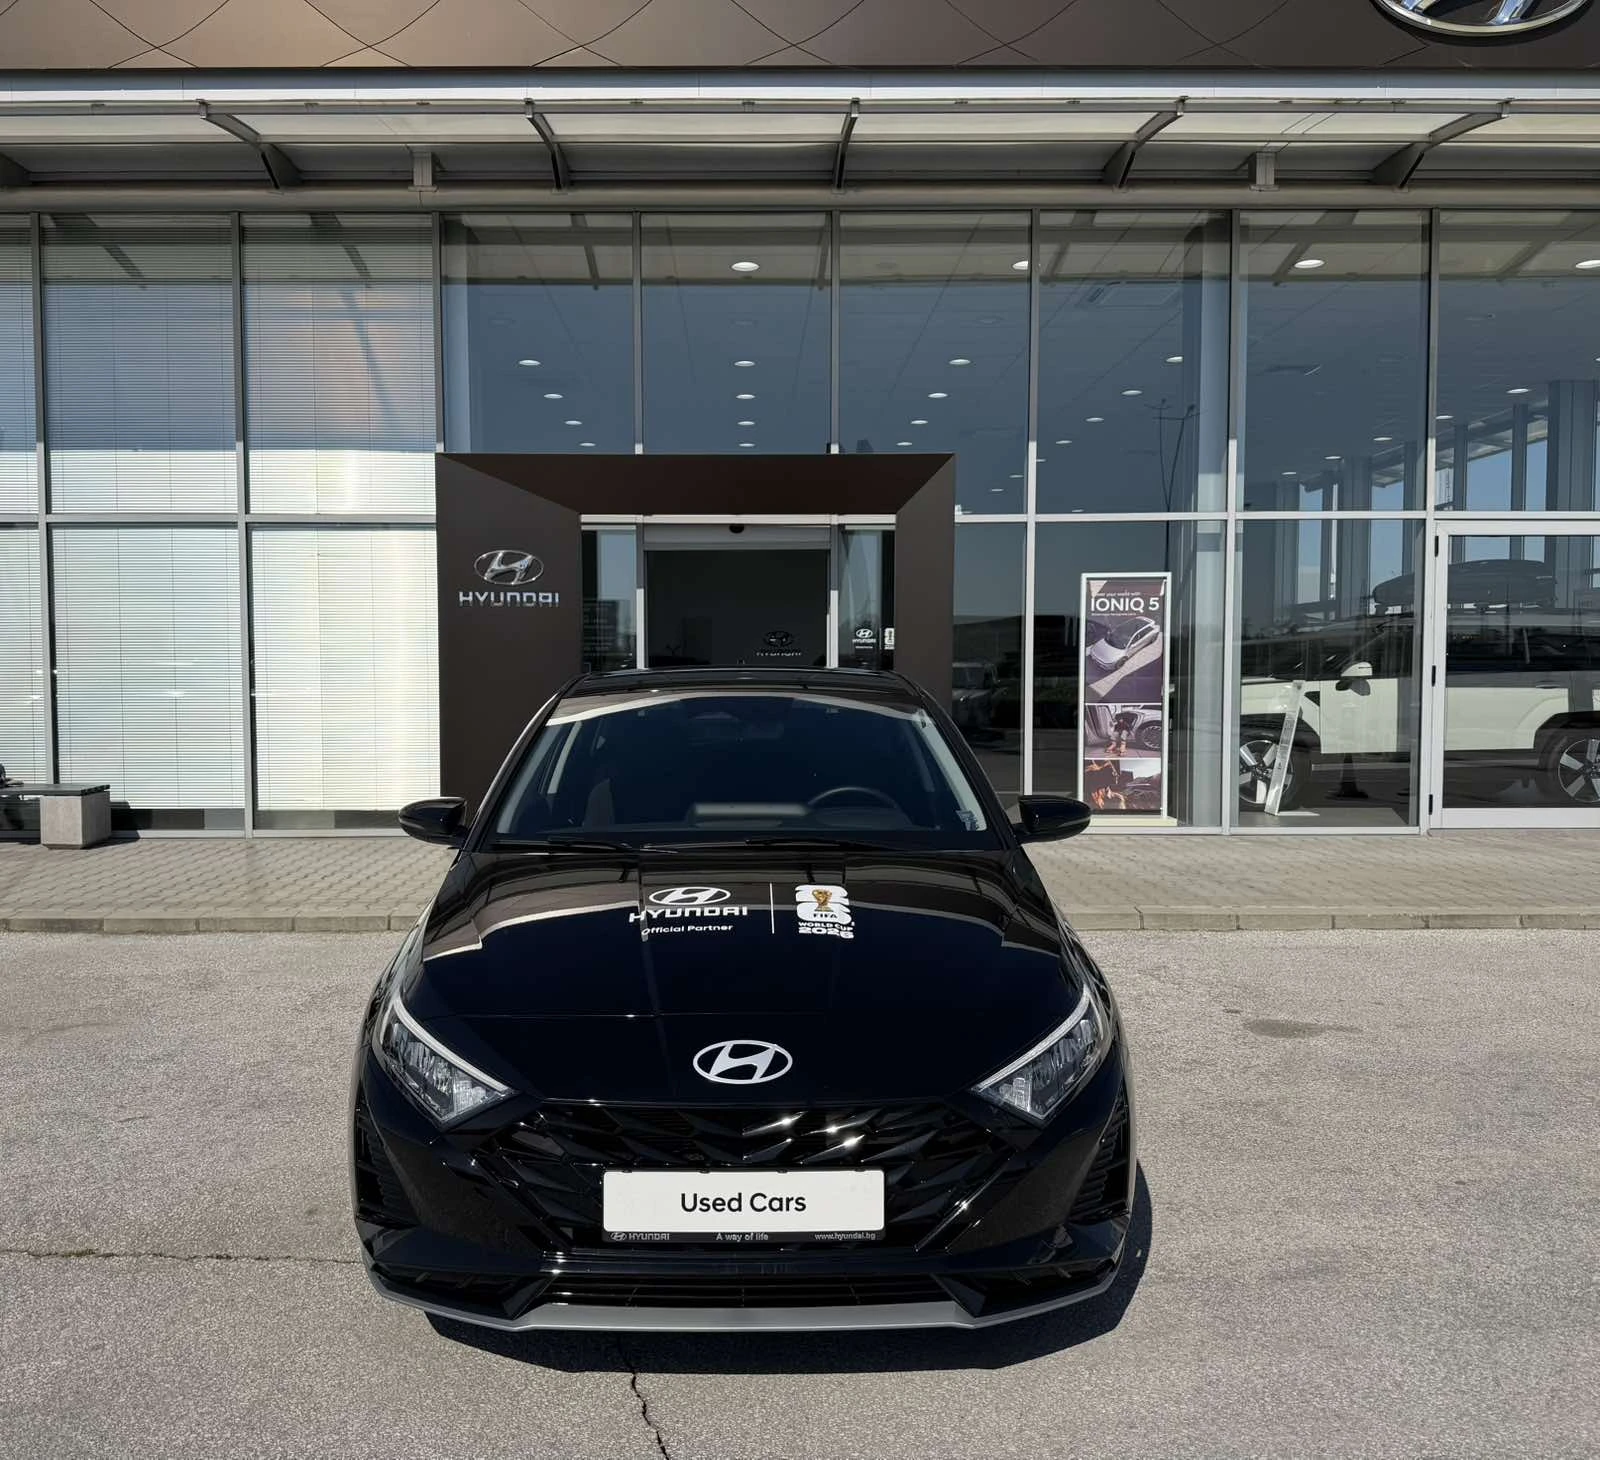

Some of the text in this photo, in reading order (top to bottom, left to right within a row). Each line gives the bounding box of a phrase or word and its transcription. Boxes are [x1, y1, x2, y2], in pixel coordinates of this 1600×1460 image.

[458, 591, 560, 607] HYUNDAI
[1091, 597, 1160, 613] IONIQ 5
[628, 906, 748, 923] HYUNDAI
[641, 924, 734, 936] Official Partner
[798, 927, 854, 939] 2026
[834, 923, 854, 931] CUP
[680, 1192, 807, 1212] Used Cars
[628, 1232, 670, 1241] HYUNDAI
[725, 1234, 742, 1242] way
[744, 1232, 754, 1240] of
[756, 1232, 769, 1240] life
[814, 1232, 876, 1242] www.hyundai.bg
